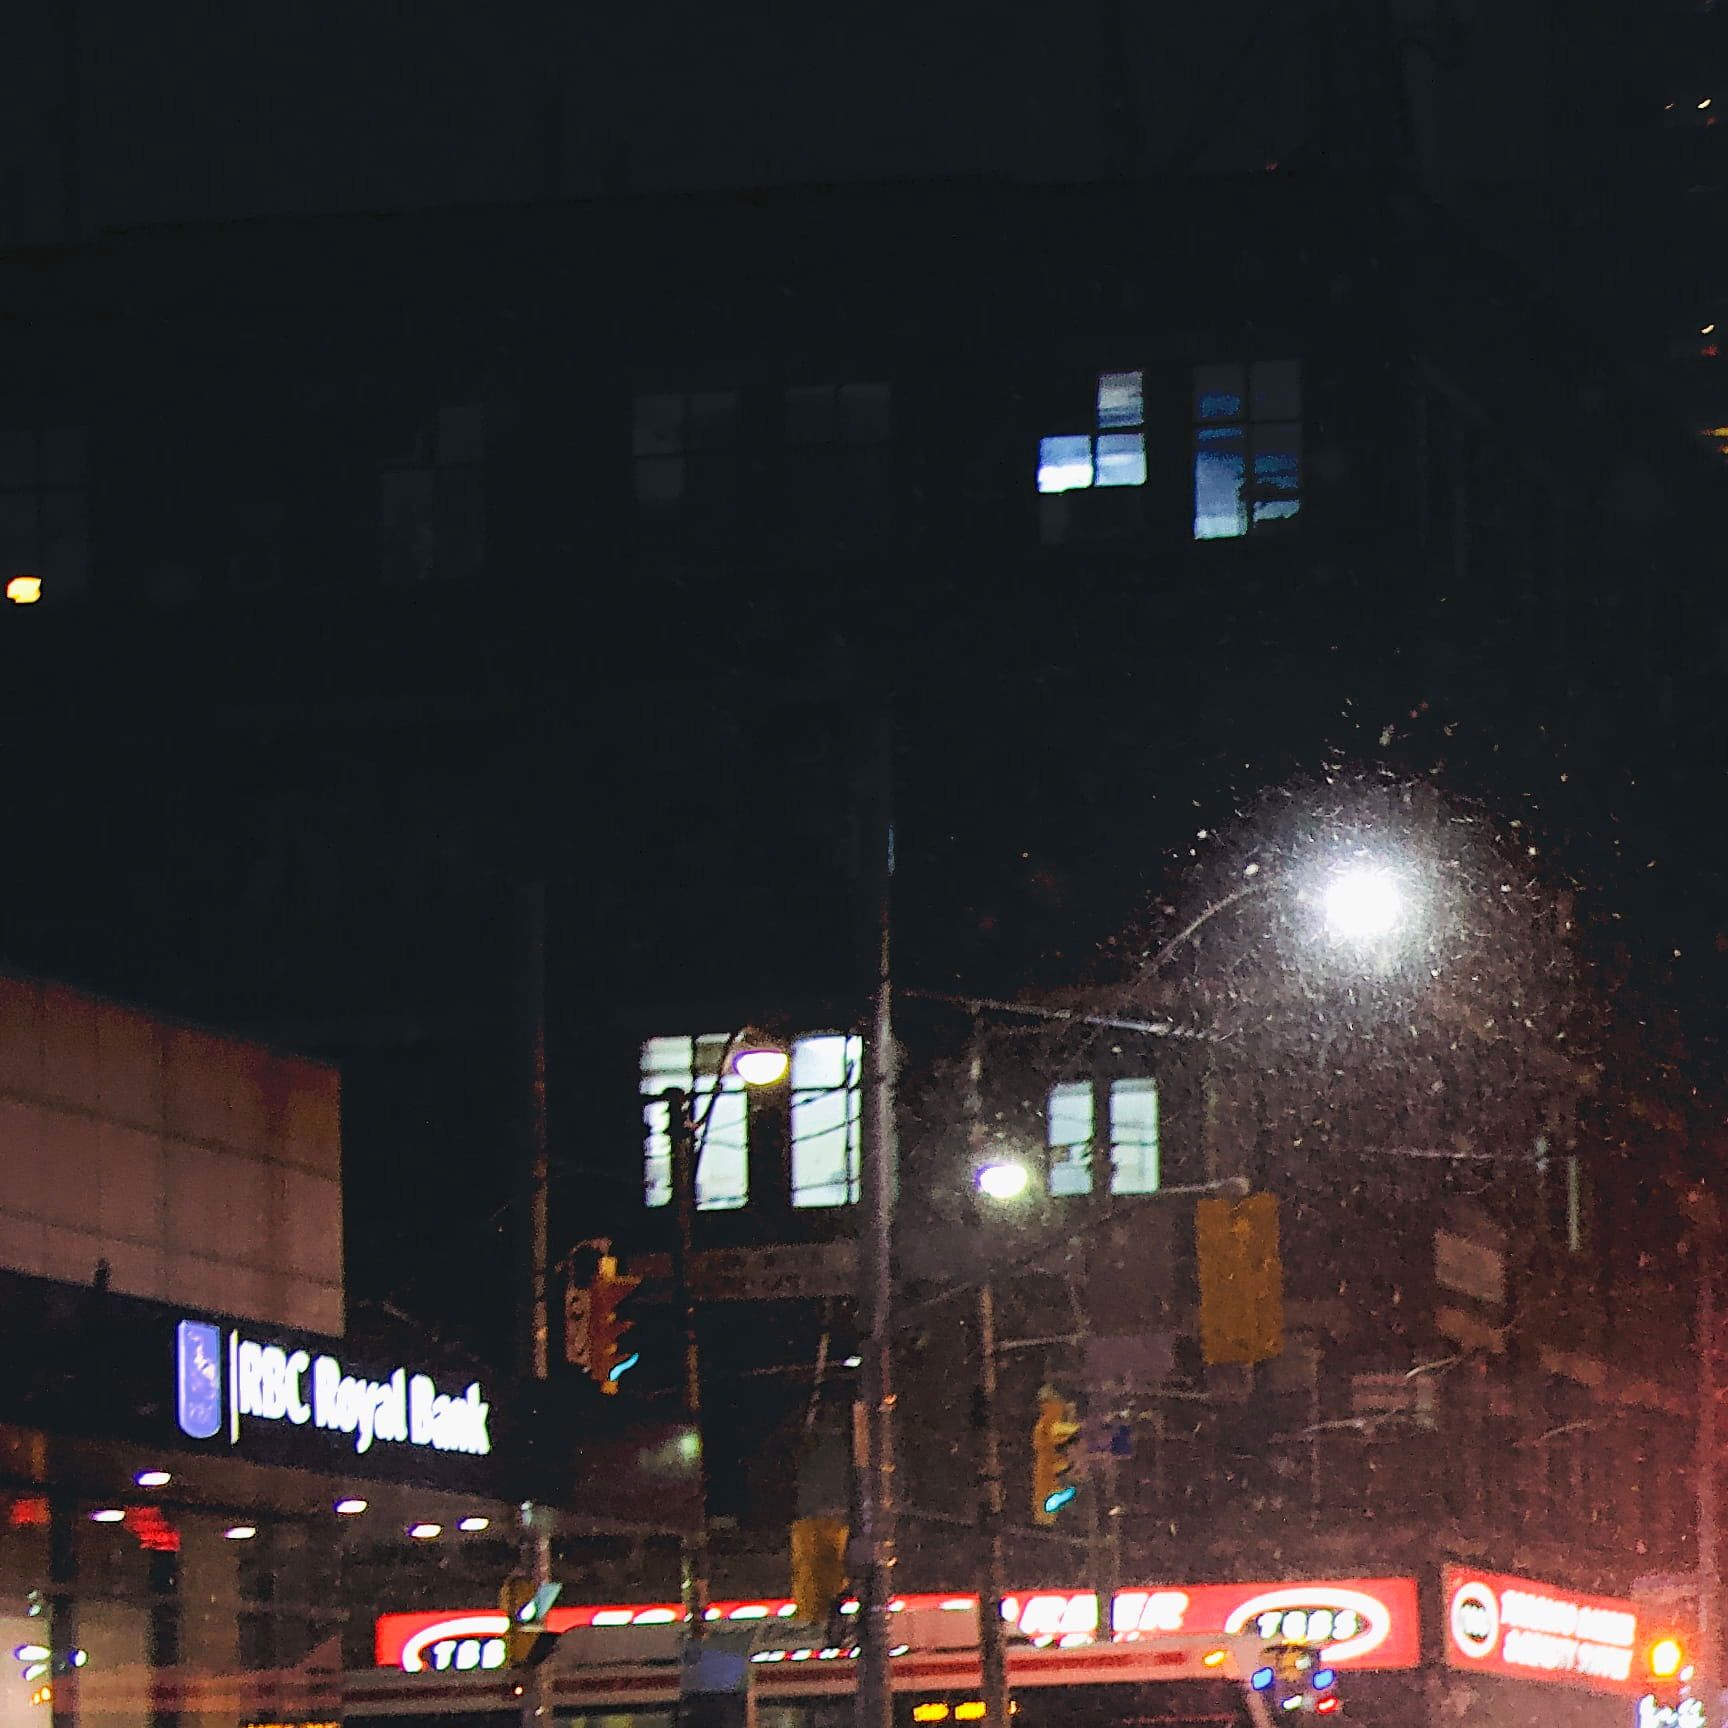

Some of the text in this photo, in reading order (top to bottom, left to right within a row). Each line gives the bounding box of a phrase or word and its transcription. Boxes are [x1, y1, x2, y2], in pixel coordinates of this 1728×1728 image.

[239, 1341, 489, 1454] RBC Royal Bank
